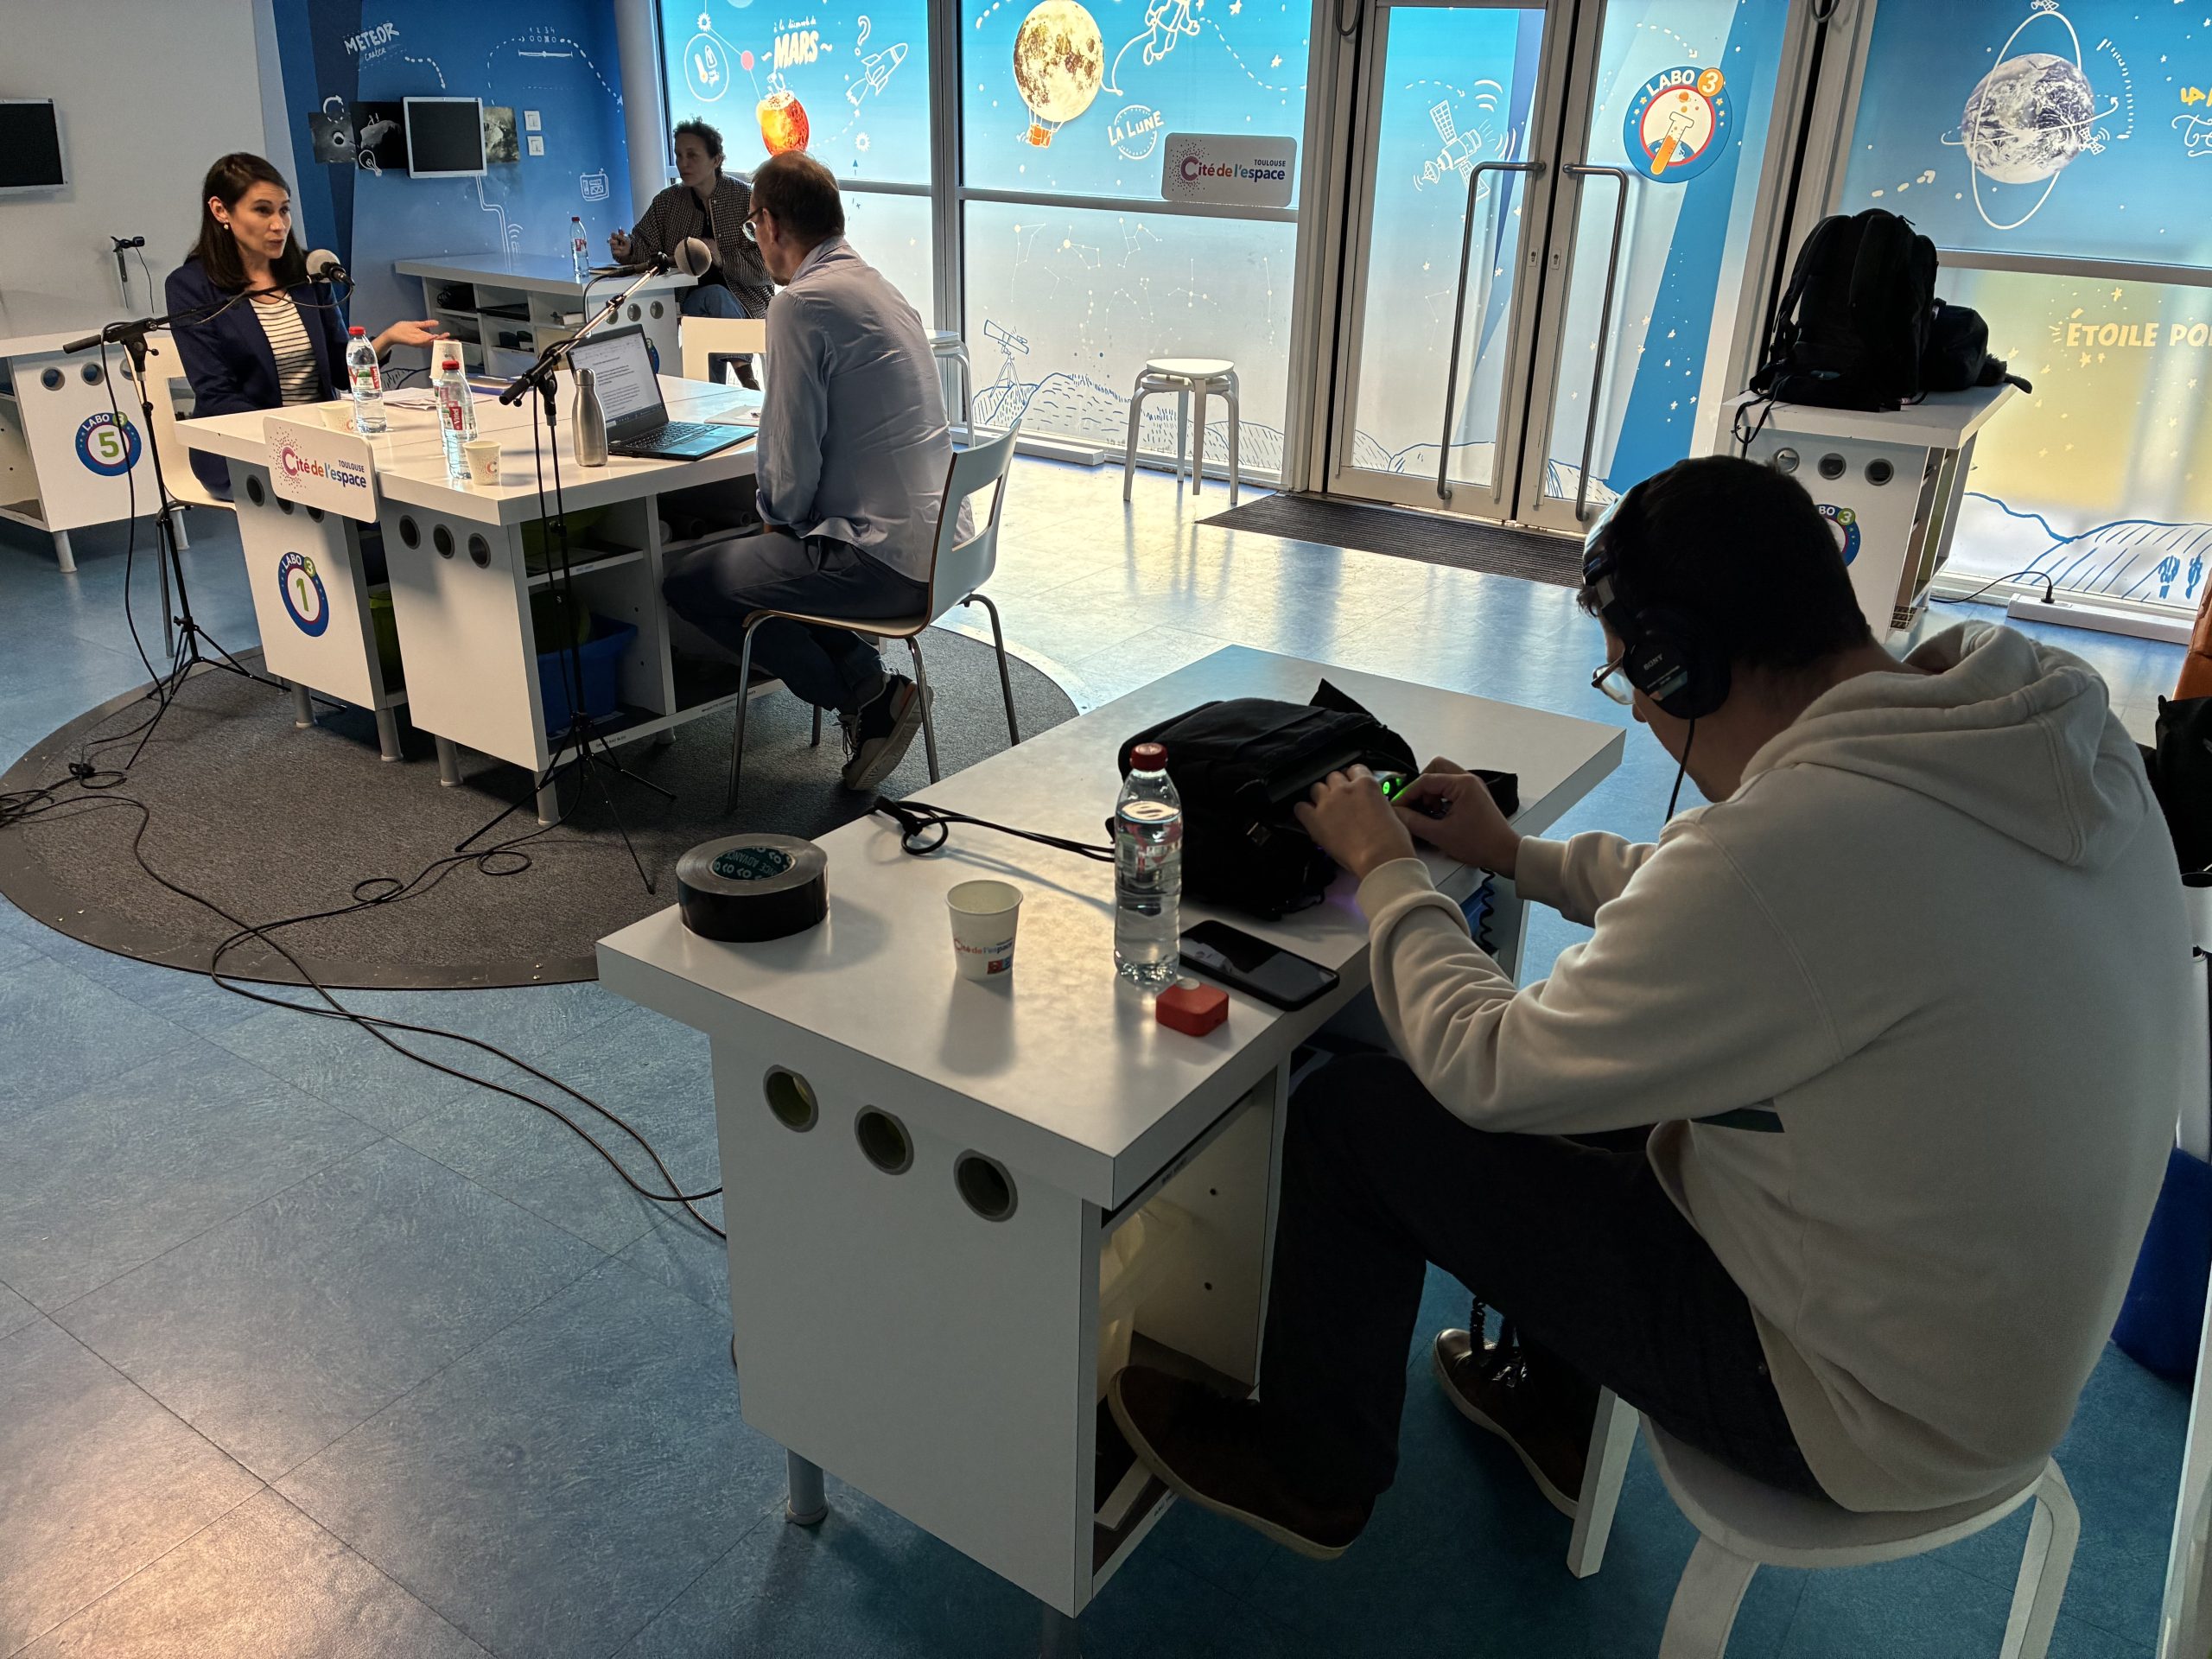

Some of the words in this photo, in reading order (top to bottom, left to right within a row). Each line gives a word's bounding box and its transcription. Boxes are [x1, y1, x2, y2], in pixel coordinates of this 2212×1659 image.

[344, 22, 400, 55] METEOR
[773, 29, 819, 70] MARS
[1645, 69, 1695, 97] LABO
[1701, 71, 1719, 94] 3
[1107, 125, 1125, 147] LA
[1126, 110, 1165, 138] LUNE
[1180, 156, 1215, 181] Cité
[1216, 162, 1233, 178] de
[1233, 163, 1286, 183] l'espace
[2066, 308, 2160, 347] ÉTOILE
[82, 414, 110, 431] LABO
[452, 407, 461, 425] Vittel
[98, 431, 120, 458] 5
[282, 446, 311, 477] Cité
[311, 459, 325, 478] de
[324, 461, 367, 489] l'espace
[338, 460, 365, 474] TOULOUSE
[1840, 511, 1853, 524] 3
[281, 553, 302, 570] LABO
[306, 560, 314, 575] 3
[296, 577, 310, 613] 1
[1643, 652, 1662, 671] SONY
